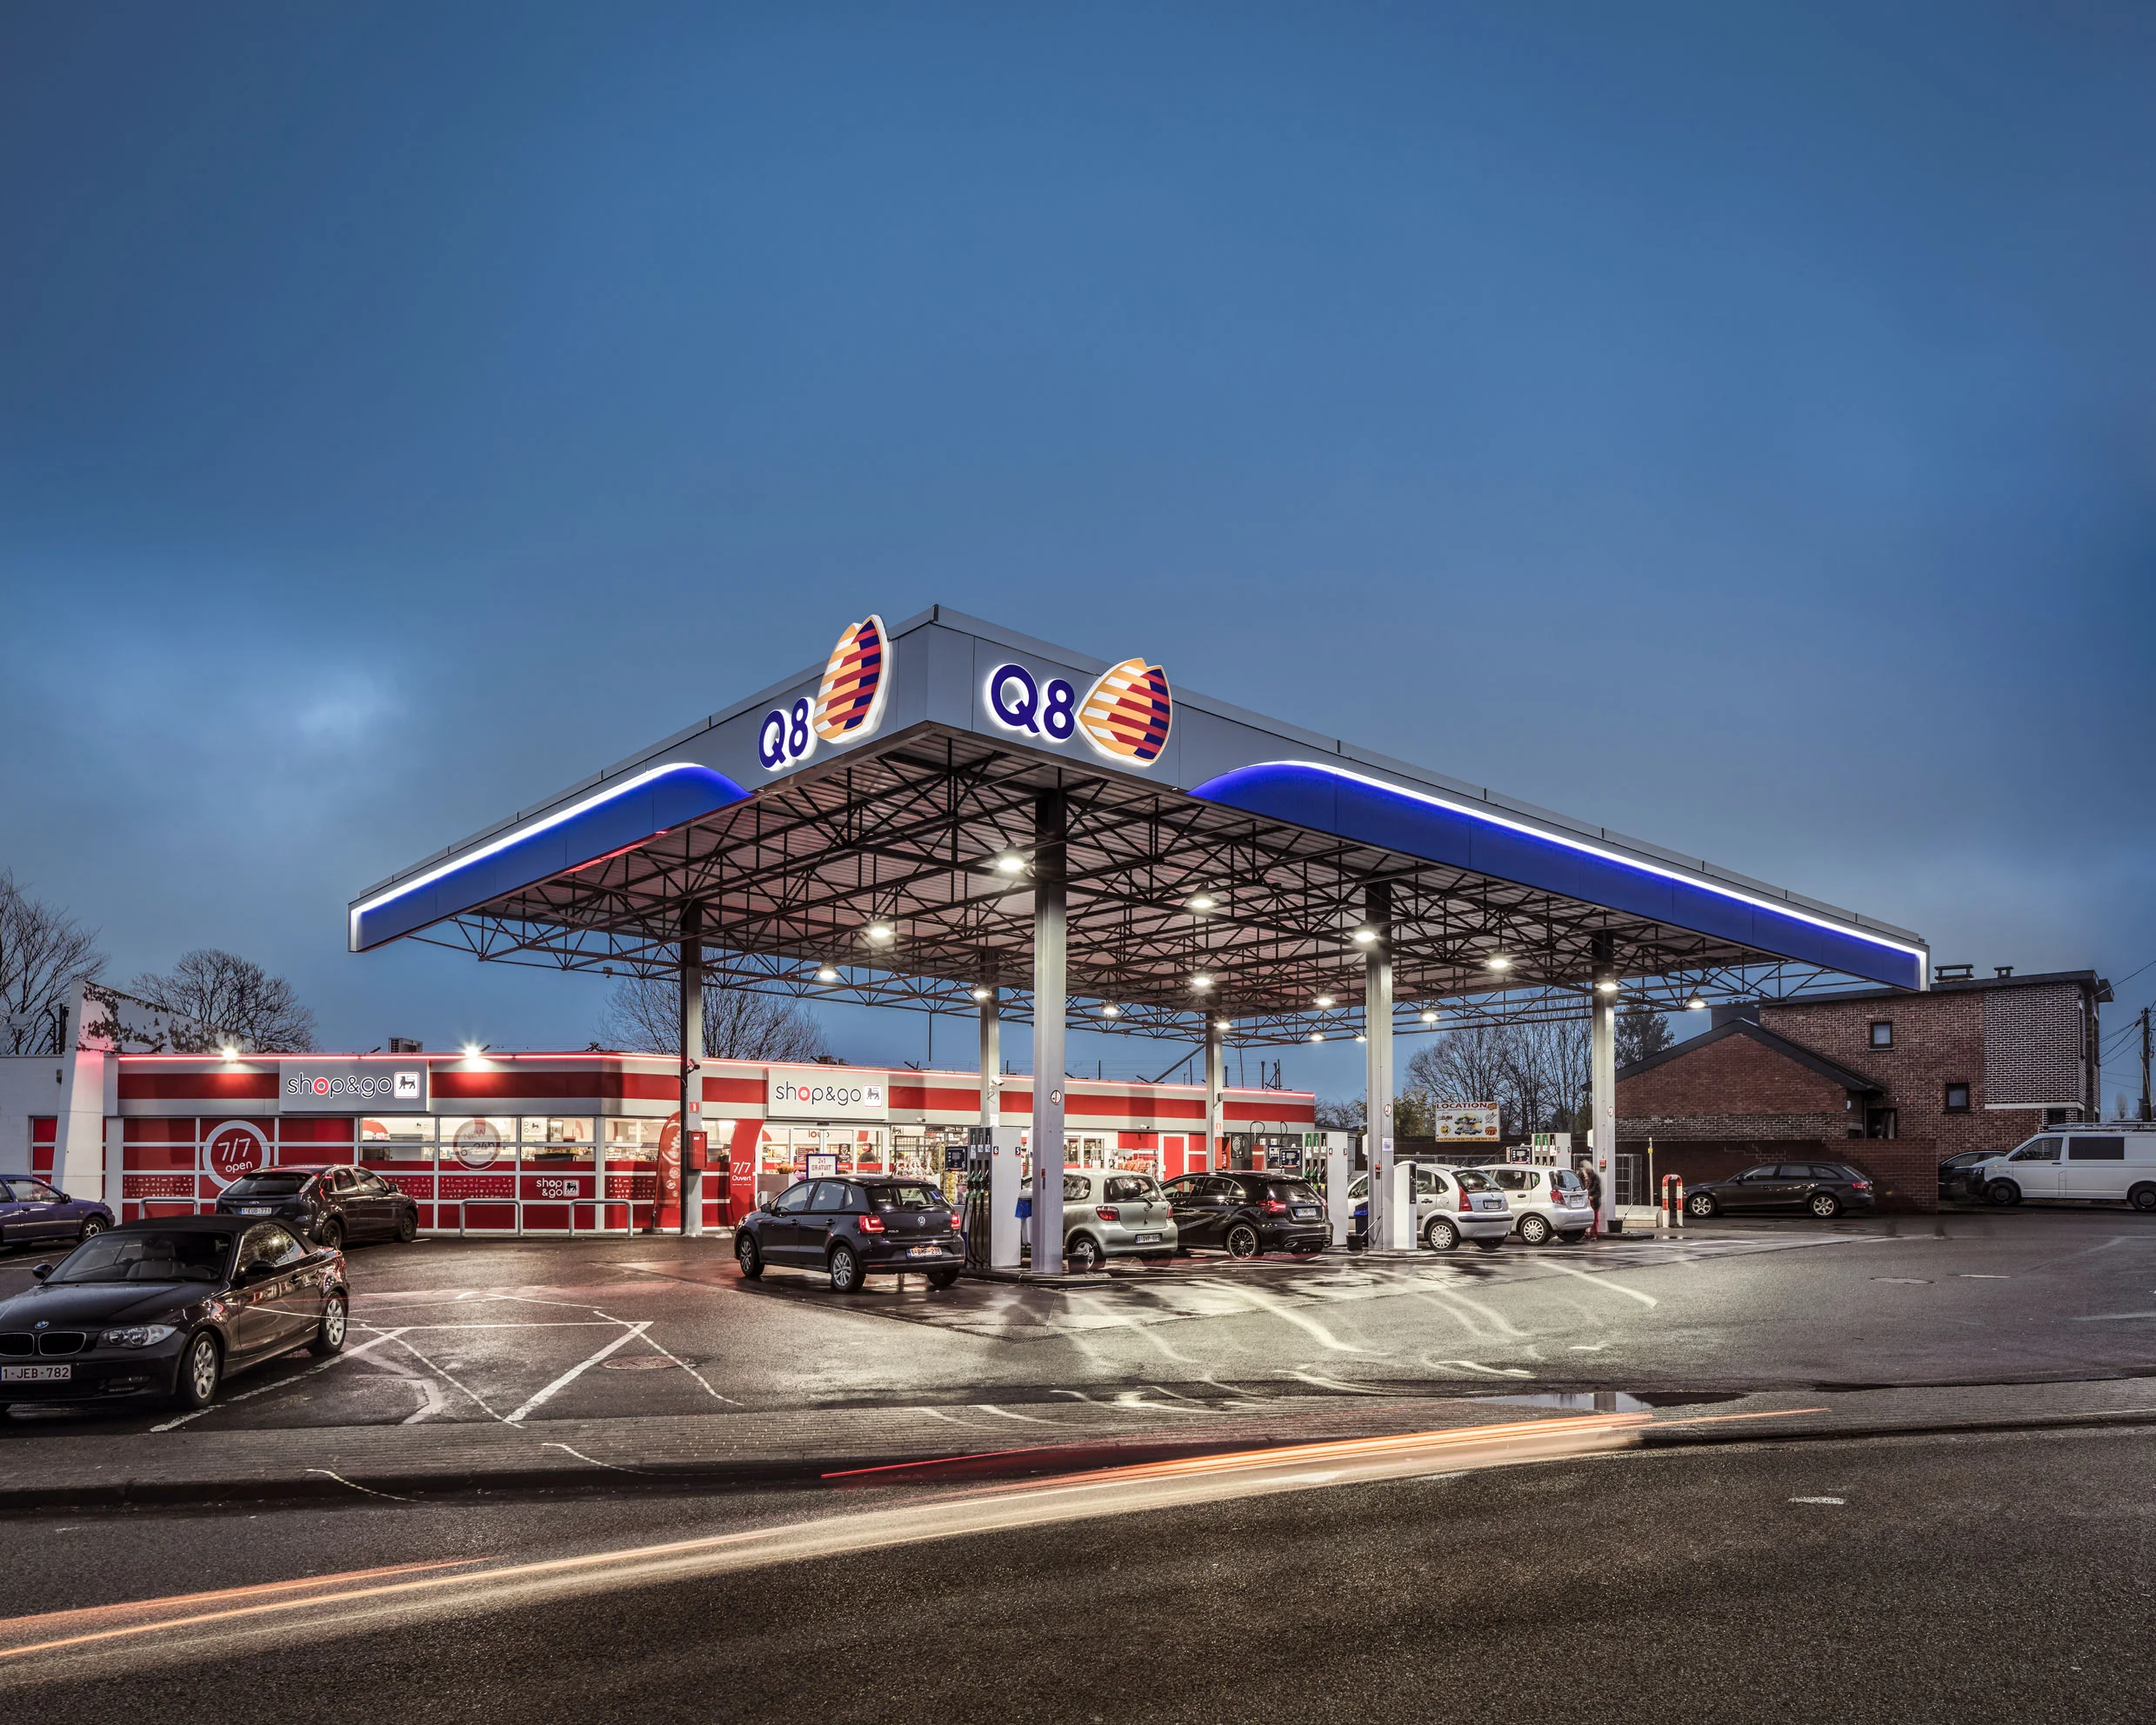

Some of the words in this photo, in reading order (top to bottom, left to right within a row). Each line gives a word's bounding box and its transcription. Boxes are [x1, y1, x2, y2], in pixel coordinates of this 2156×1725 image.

[989, 663, 1076, 741] Q8
[758, 696, 811, 770] Q8
[287, 1072, 392, 1099] shop&go
[776, 1081, 862, 1106] shop&go
[218, 1138, 251, 1162] 7/7
[225, 1162, 253, 1173] open
[732, 1162, 751, 1175] 7/7
[536, 1177, 563, 1189] shop
[542, 1188, 563, 1198] &go
[3, 1367, 70, 1379] 1-JEB-782
